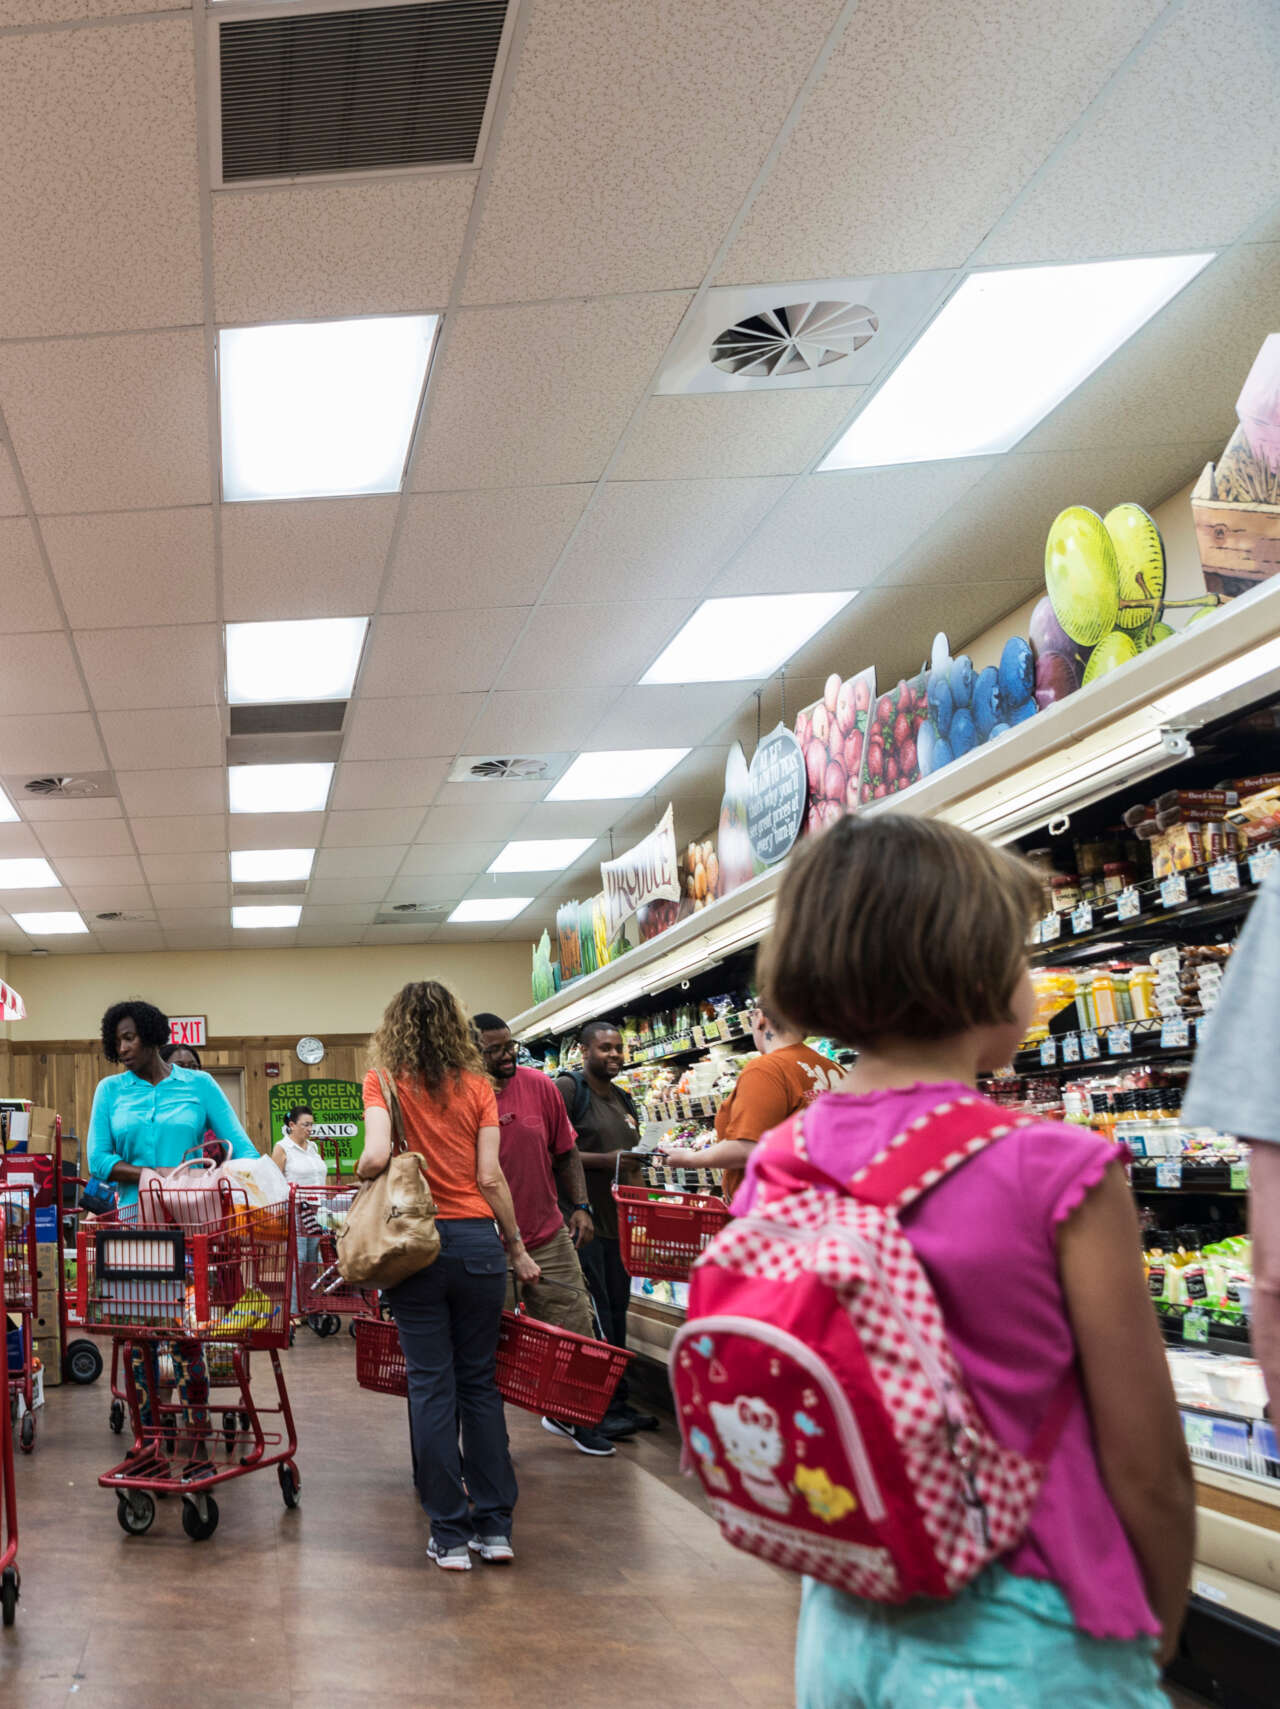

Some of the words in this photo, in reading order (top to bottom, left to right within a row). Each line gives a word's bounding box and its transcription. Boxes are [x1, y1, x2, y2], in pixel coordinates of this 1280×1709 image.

[606, 829, 673, 932] PRODUCE
[170, 1021, 202, 1045] EXIT
[278, 1084, 304, 1097] SEE
[308, 1084, 361, 1097] GREEN.
[271, 1098, 308, 1111] SHOP
[322, 1112, 363, 1122] SHOPPING
